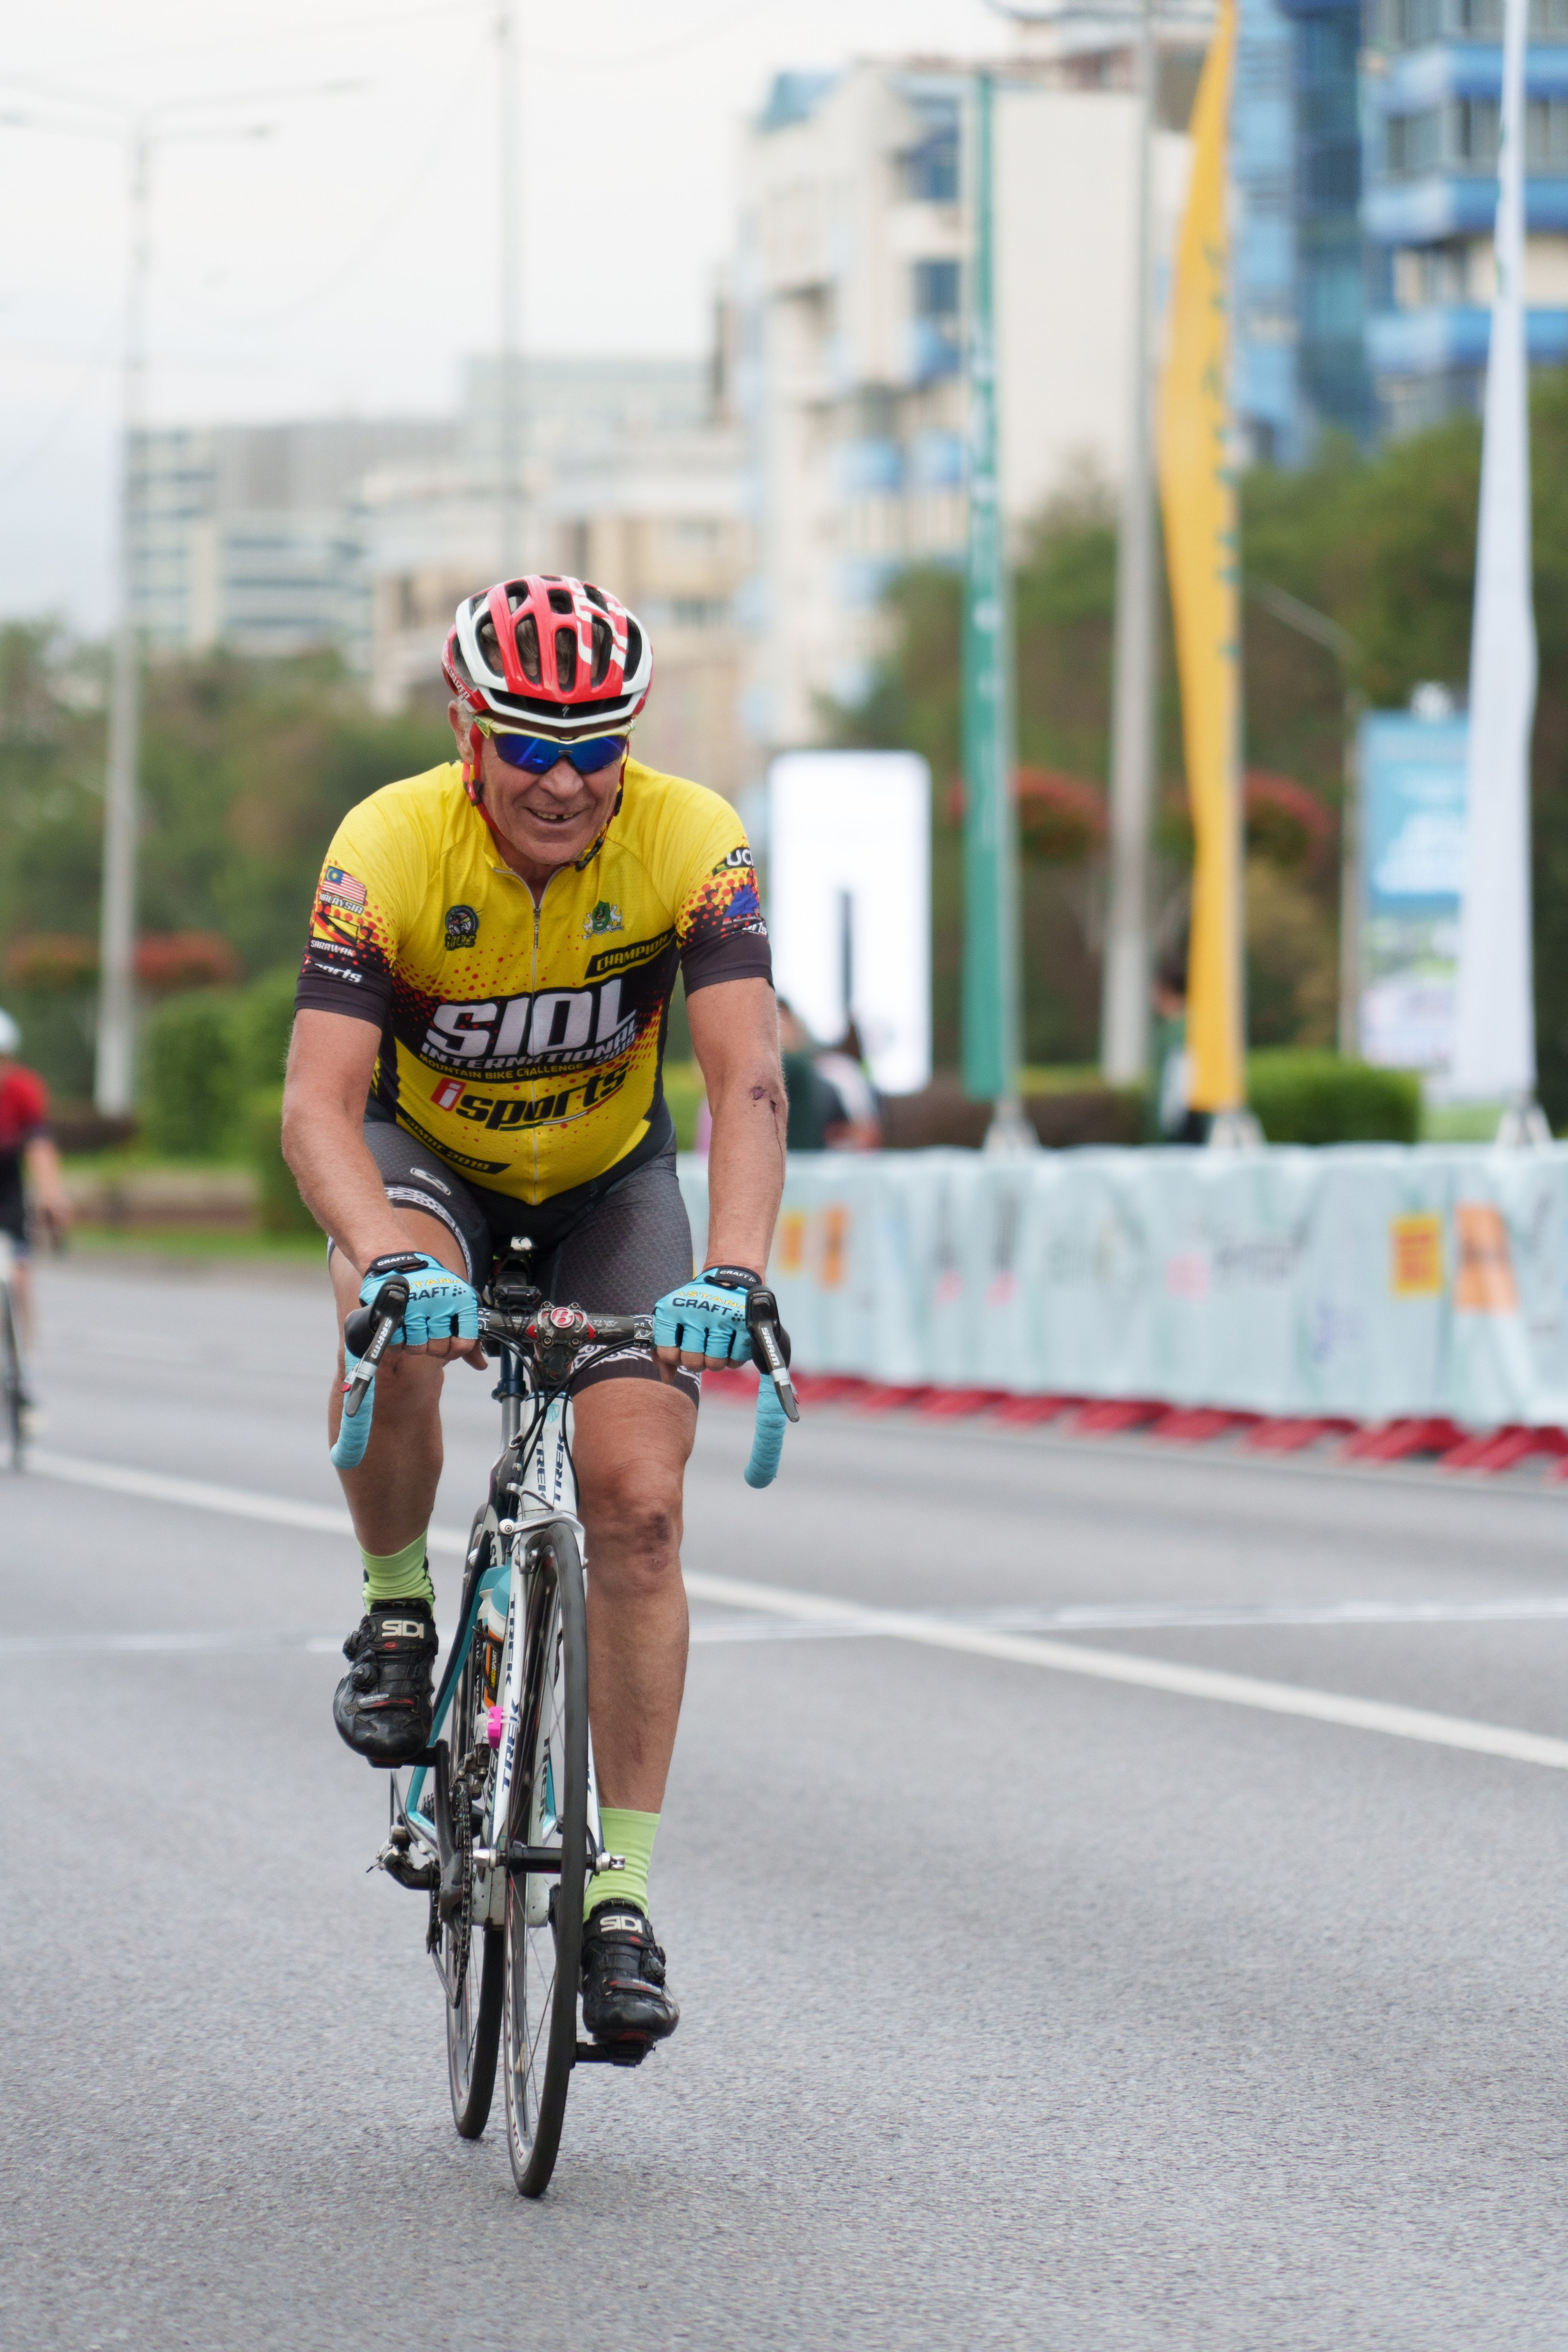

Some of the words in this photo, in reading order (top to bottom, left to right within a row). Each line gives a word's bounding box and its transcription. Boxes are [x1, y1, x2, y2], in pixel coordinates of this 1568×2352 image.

[319, 892, 364, 915] MALAYSIA
[311, 940, 356, 957] SARAWAK
[596, 934, 669, 972] CHAMPION
[426, 978, 637, 1058] SIOL
[421, 1019, 638, 1069] INTERNATIONAL
[419, 1053, 482, 1079] MOUNTAIN
[484, 1070, 514, 1080] BIKE
[516, 1063, 584, 1077] CHALLENGE
[377, 1256, 406, 1267] CRAFT
[409, 1278, 464, 1289] TANA
[719, 1270, 749, 1279] CRAFT
[407, 1286, 450, 1303] RAFT
[672, 1297, 732, 1316] CRAFT
[371, 1317, 393, 1359] SRAM
[761, 1327, 780, 1366] SRAM
[553, 1430, 564, 1506] TREK
[382, 1619, 424, 1640] SIDI
[505, 1593, 516, 1687] TREK
[502, 1698, 519, 1792] TREK
[600, 1915, 643, 1934] SIDI
